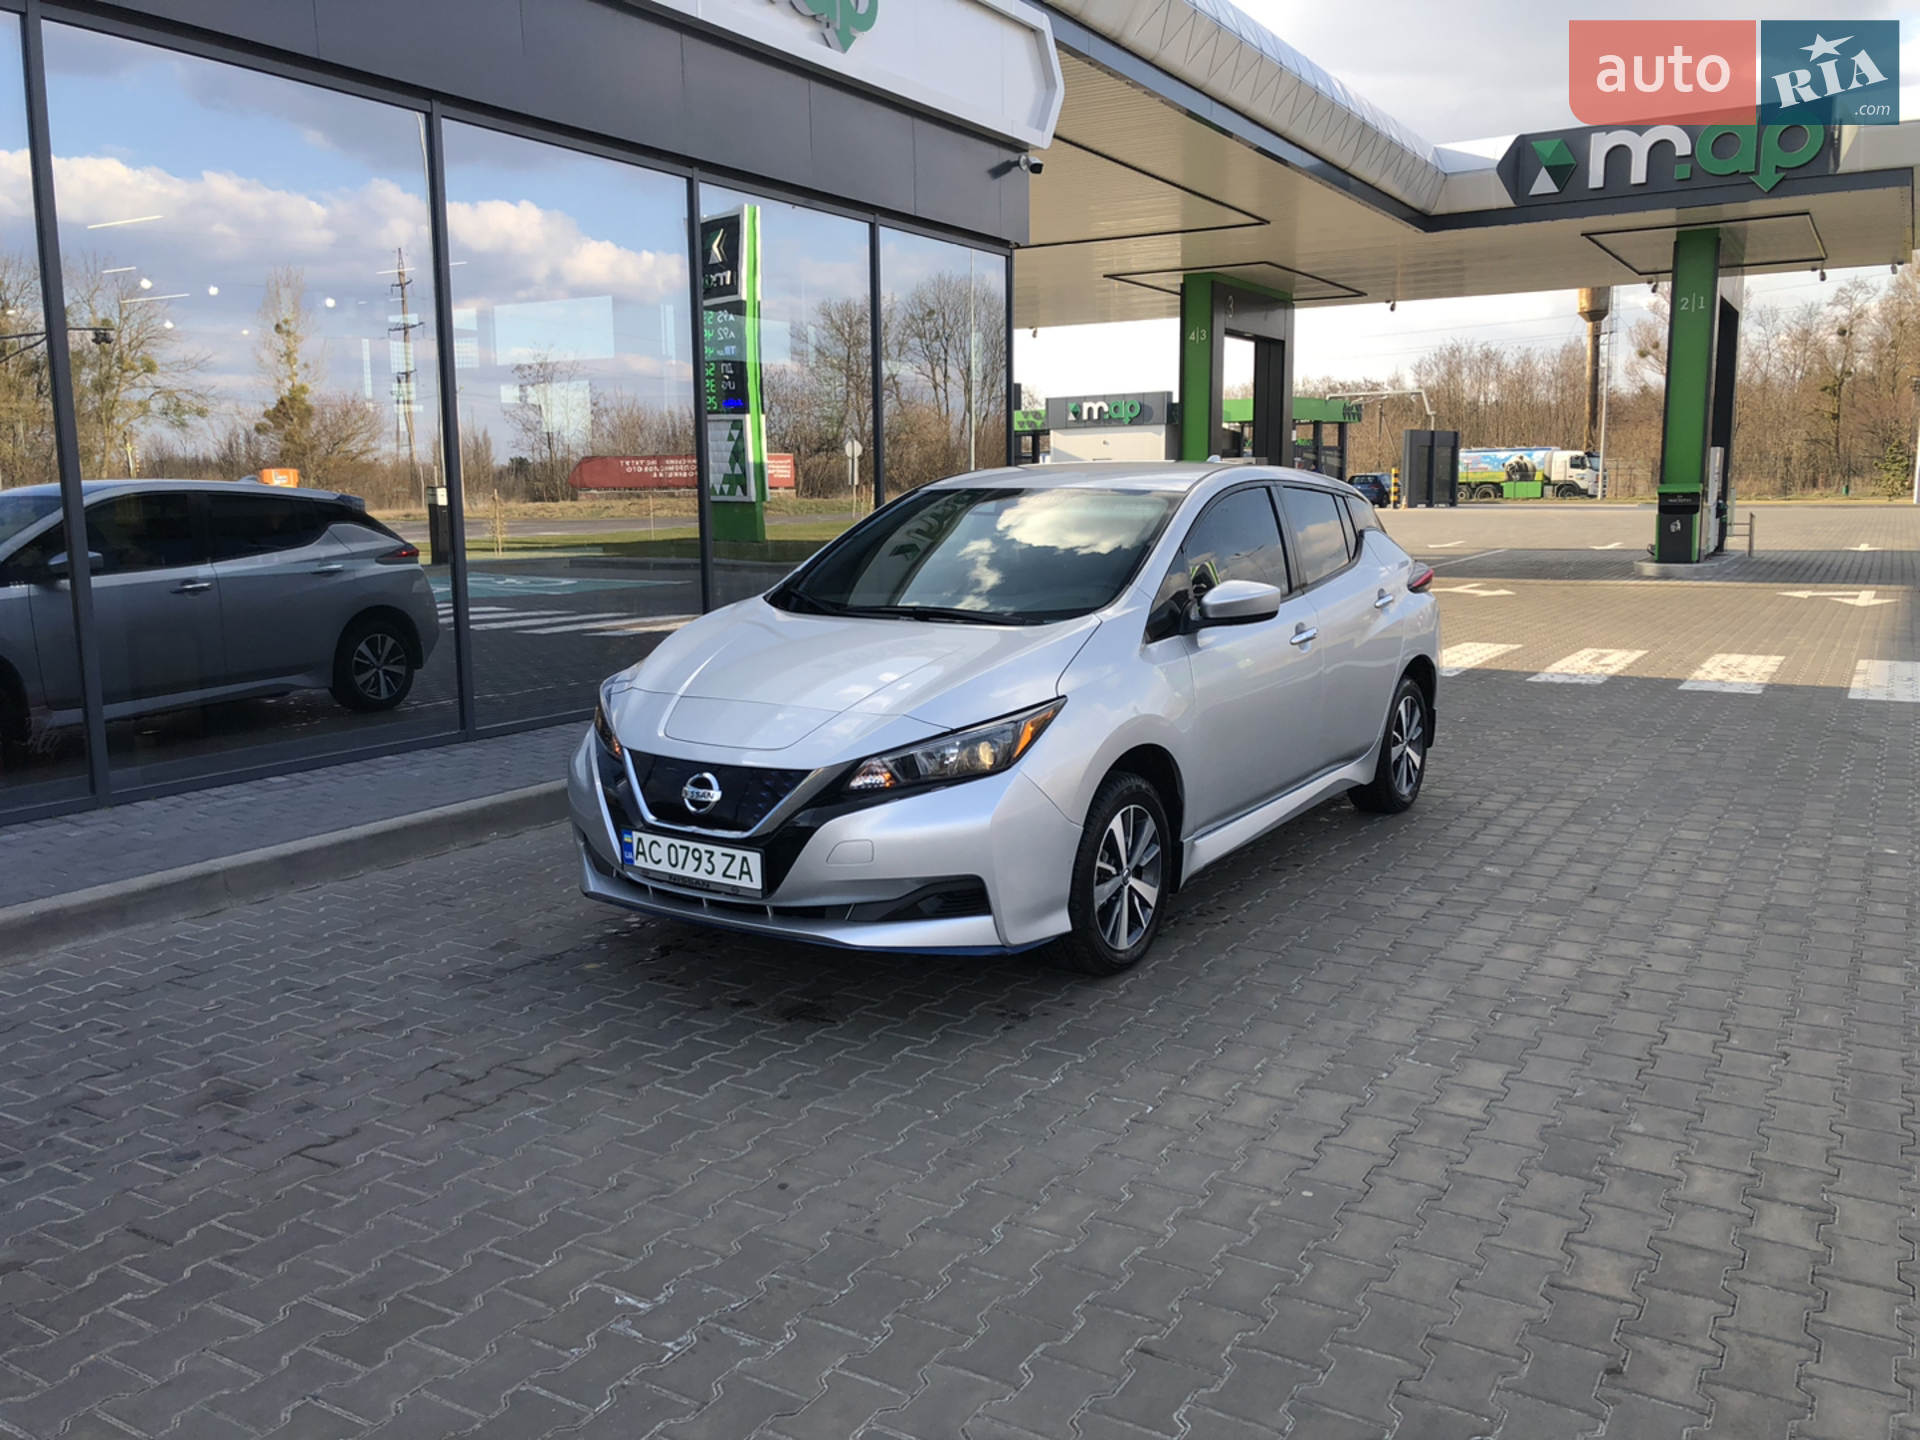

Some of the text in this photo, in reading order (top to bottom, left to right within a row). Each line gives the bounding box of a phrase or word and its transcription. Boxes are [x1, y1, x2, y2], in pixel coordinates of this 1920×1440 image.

[635, 837, 754, 883] AC 0793 ZA
